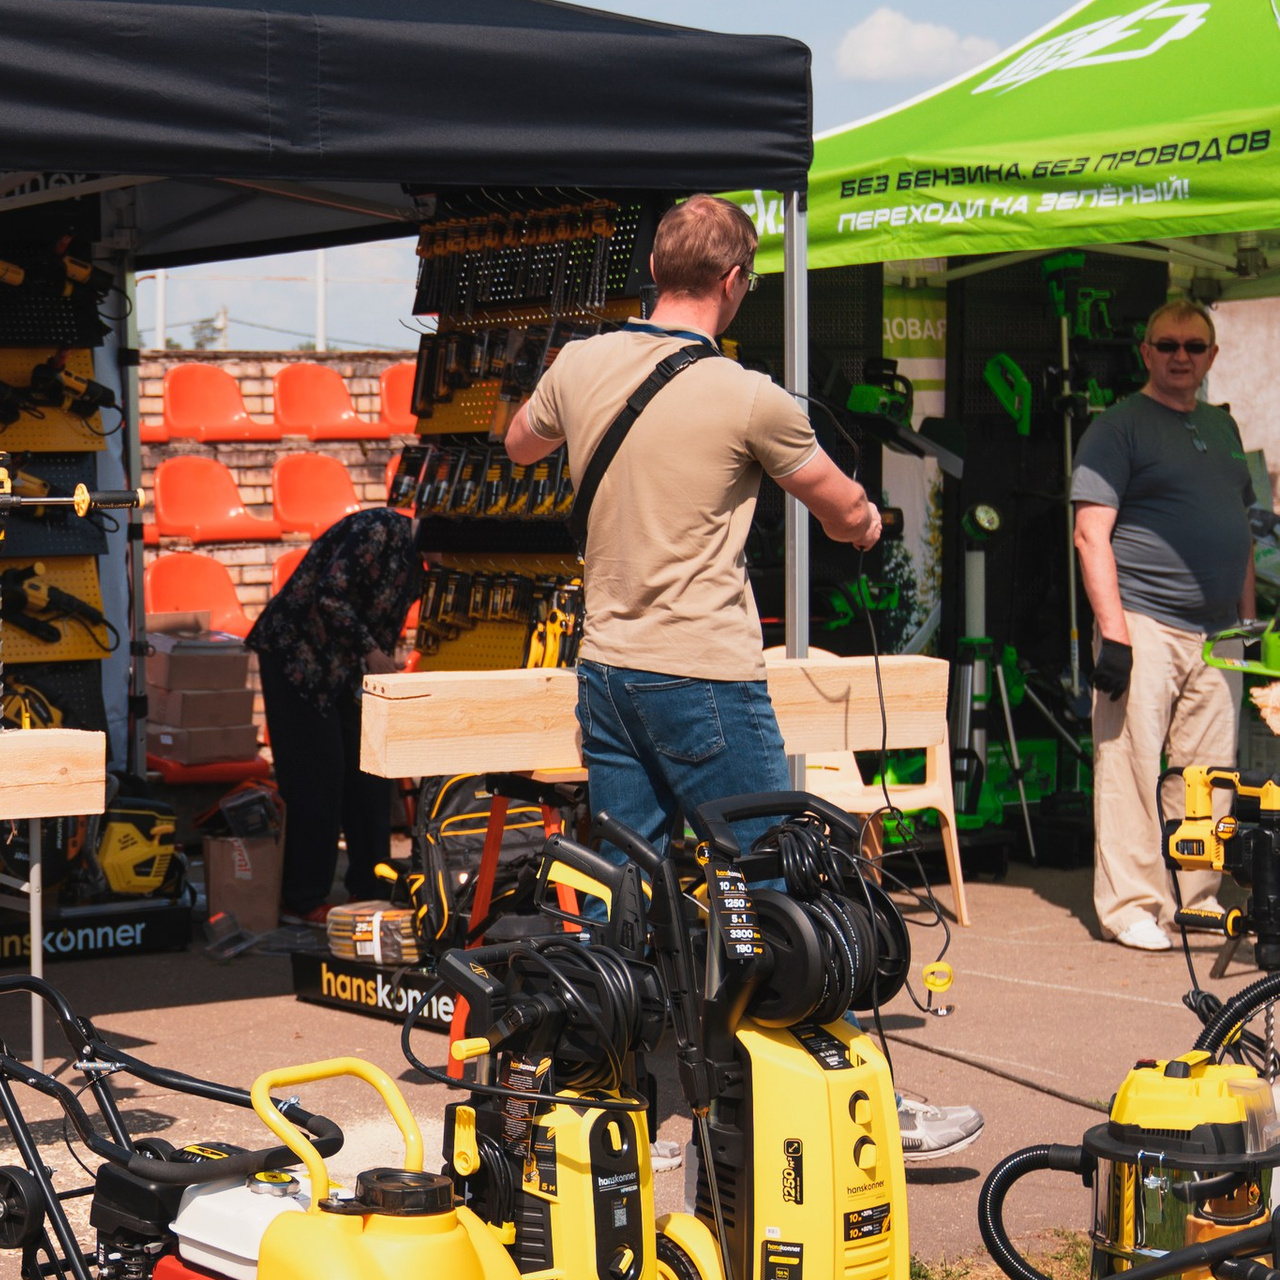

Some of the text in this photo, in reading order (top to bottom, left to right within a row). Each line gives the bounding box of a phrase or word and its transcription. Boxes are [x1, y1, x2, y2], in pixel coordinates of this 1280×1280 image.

[840, 174, 890, 200] БЕЗ
[1032, 157, 1090, 180] БЕЗ
[1093, 129, 1271, 172] ПРОВОДОВ
[837, 176, 1191, 234] ПЕРЕХОДИ НА ЗЕЛЁНЫЙ!
[724, 899, 745, 908] 1250
[730, 929, 753, 938] 3300
[735, 944, 752, 953] 190
[321, 963, 456, 1022] hanskonne
[598, 1172, 637, 1187] hanskonner
[783, 1168, 796, 1202] 1250
[846, 1180, 885, 1195] hanskonner
